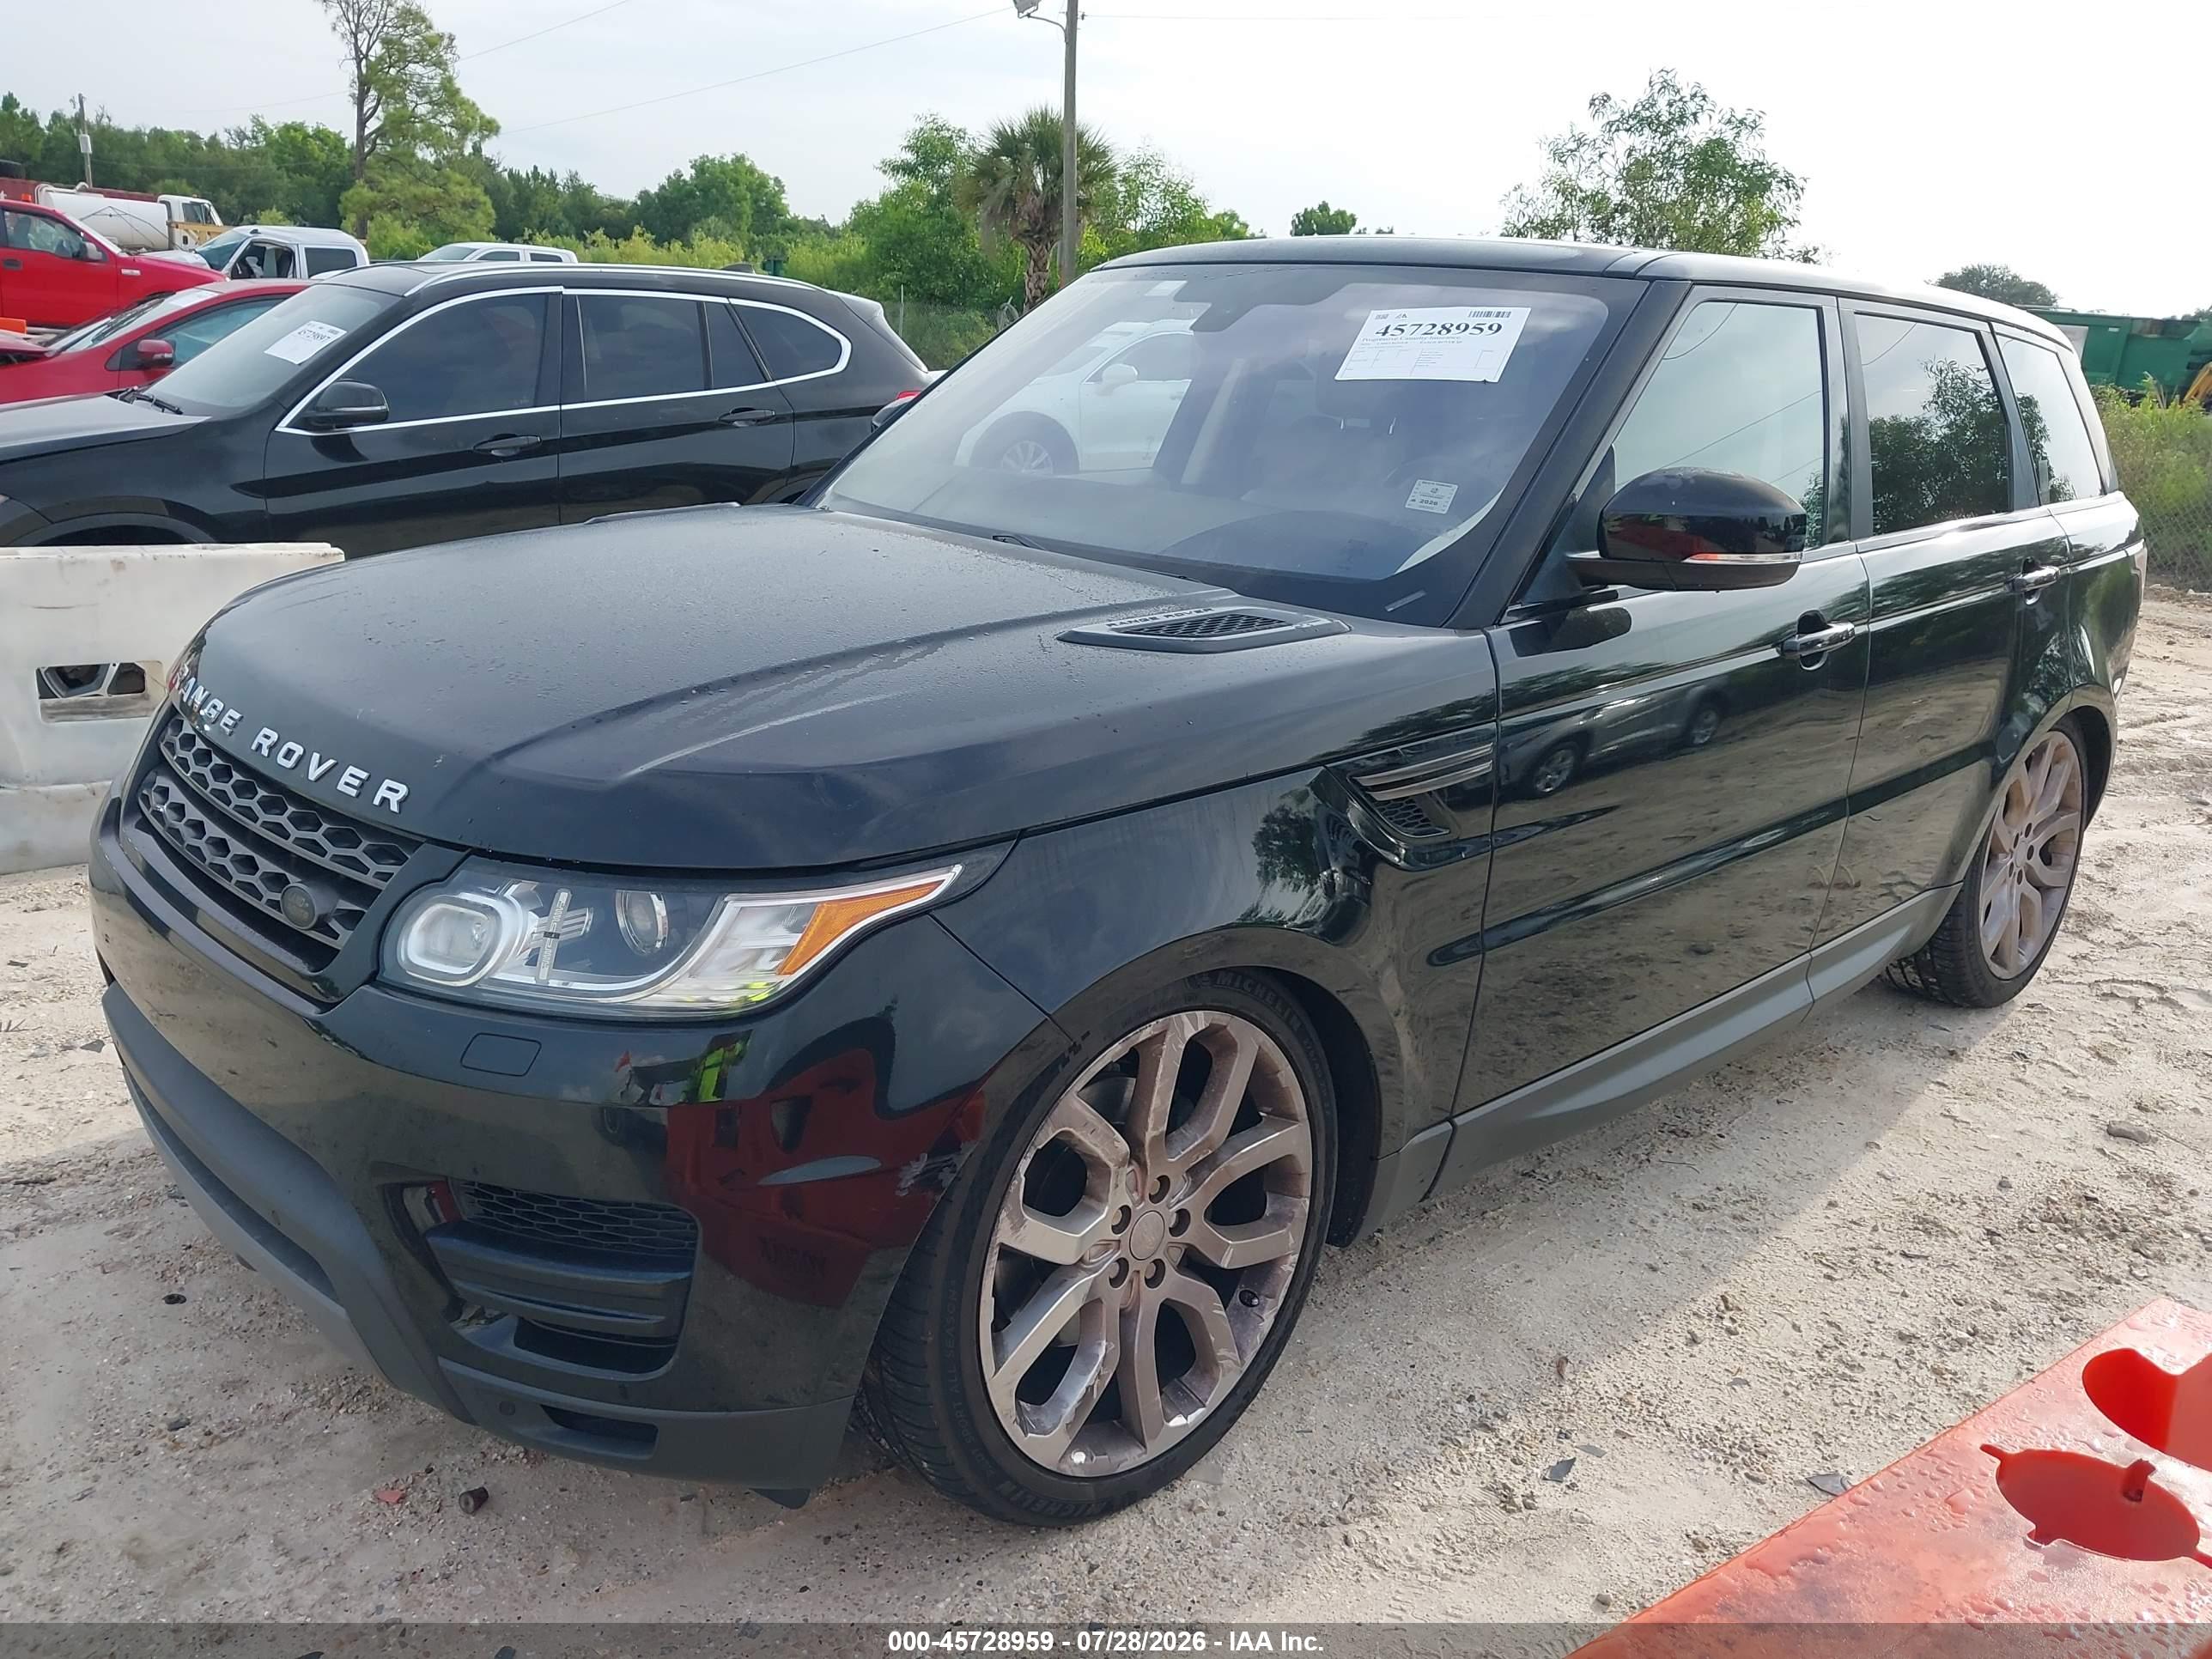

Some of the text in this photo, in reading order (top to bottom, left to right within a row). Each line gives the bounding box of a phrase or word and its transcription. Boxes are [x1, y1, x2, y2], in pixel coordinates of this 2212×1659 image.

[1375, 322, 1503, 337] 45728959
[250, 726, 410, 814] ROVER
[1215, 970, 1304, 1030] MICHELIN
[947, 1369, 961, 1395] ALL
